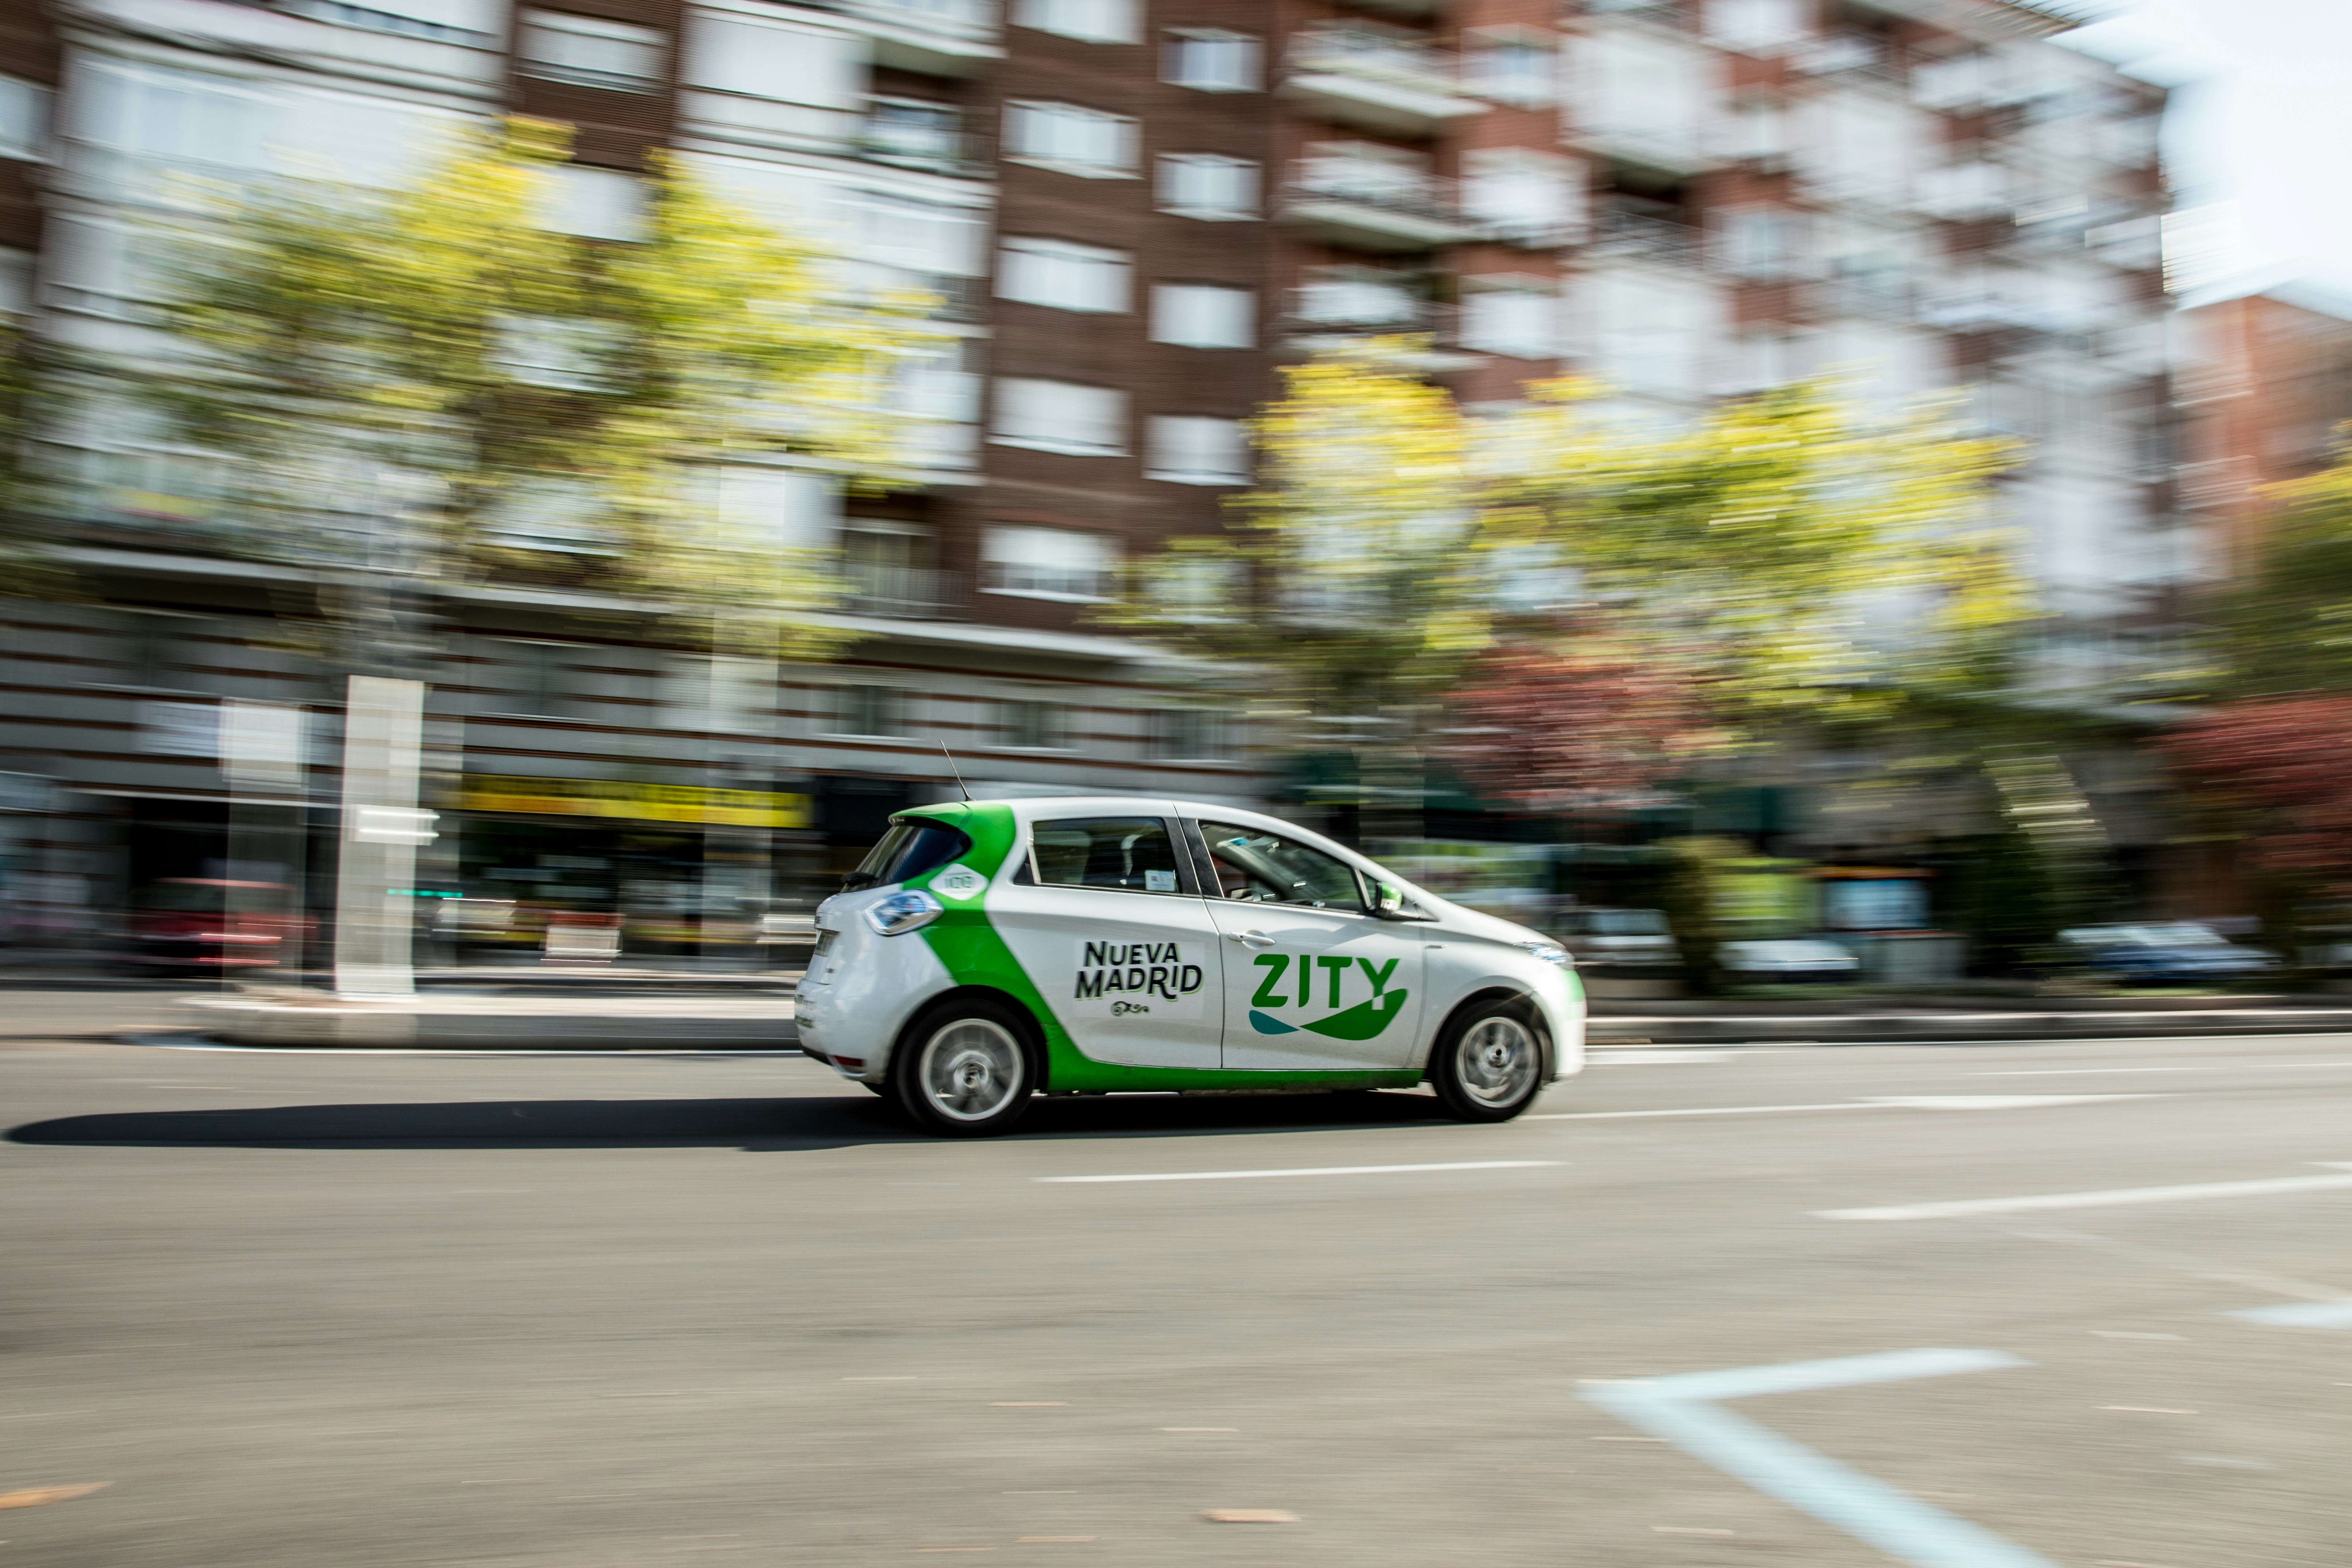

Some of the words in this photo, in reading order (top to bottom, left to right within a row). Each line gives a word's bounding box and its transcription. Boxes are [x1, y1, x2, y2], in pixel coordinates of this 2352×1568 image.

[1083, 941, 1181, 966] NUEVA
[1074, 965, 1204, 1002] MADRID
[1251, 954, 1401, 1010] ZITY
